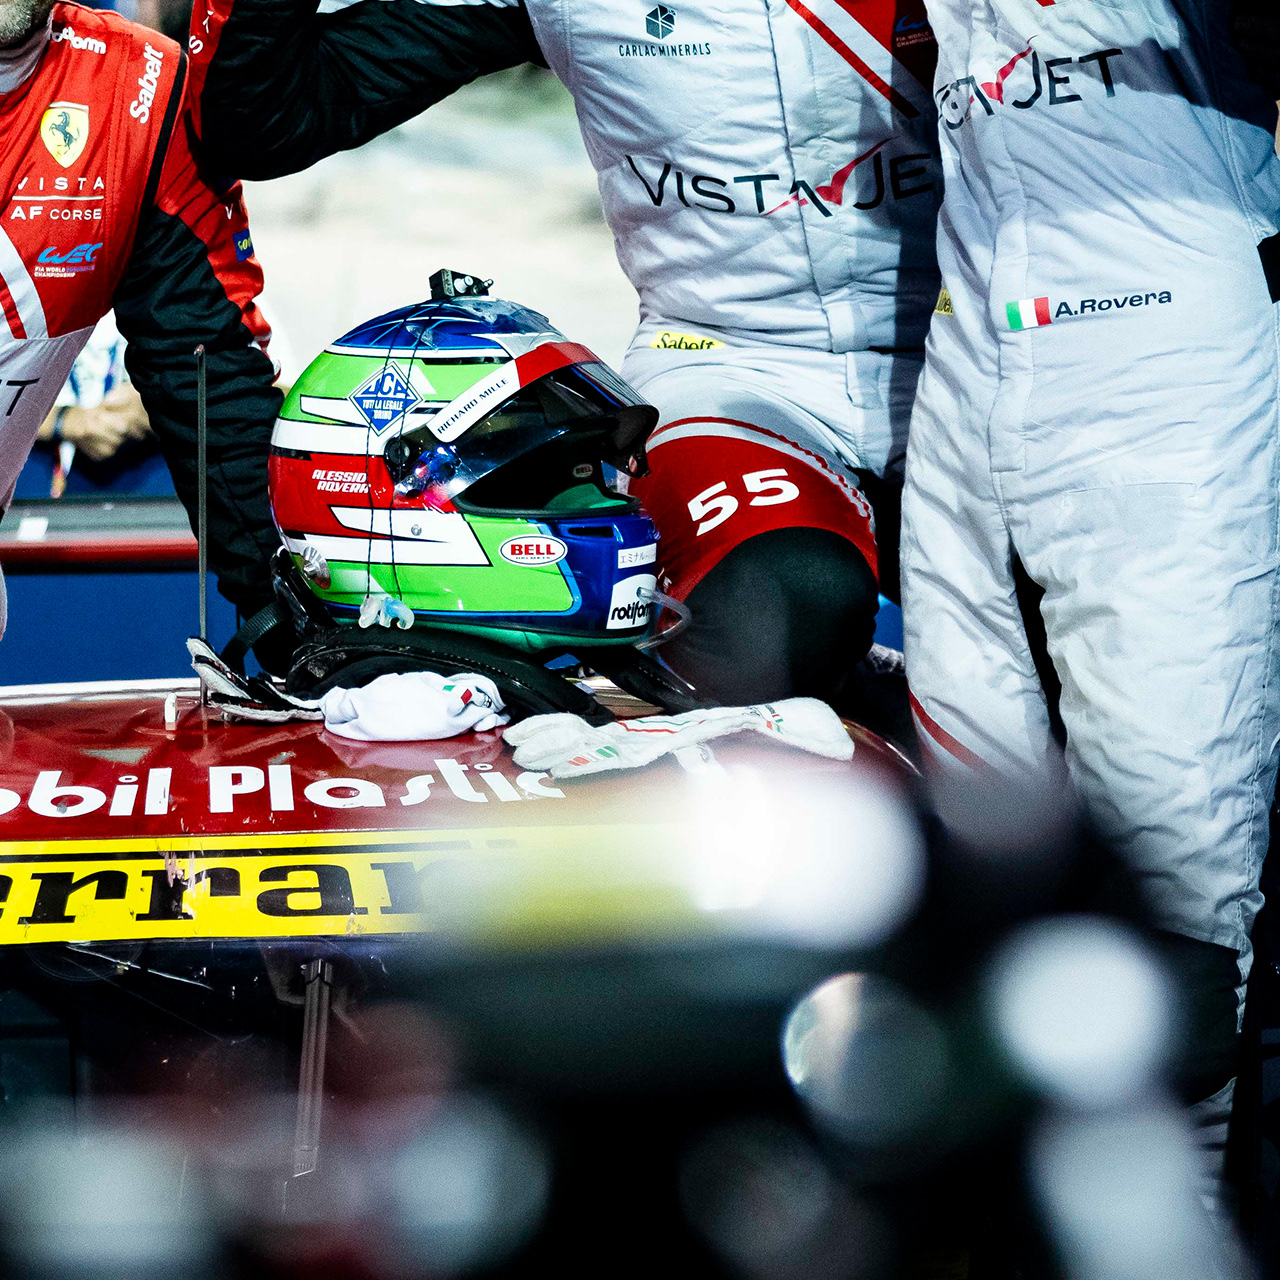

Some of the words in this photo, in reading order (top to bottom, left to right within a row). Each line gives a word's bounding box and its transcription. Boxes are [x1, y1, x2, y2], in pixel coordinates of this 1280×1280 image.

[129, 41, 165, 124] Sabelt
[17, 176, 105, 191] VISTA
[10, 205, 44, 220] AF
[49, 207, 102, 220] CORSE
[37, 242, 104, 264] WEC
[1054, 290, 1172, 318] A.Rovera
[436, 398, 478, 436] RICHARD
[479, 377, 510, 400] MILLE
[312, 469, 367, 483] ALESSIO
[687, 468, 800, 537] 55
[510, 544, 556, 556] BELL
[209, 758, 567, 815] Plastic
